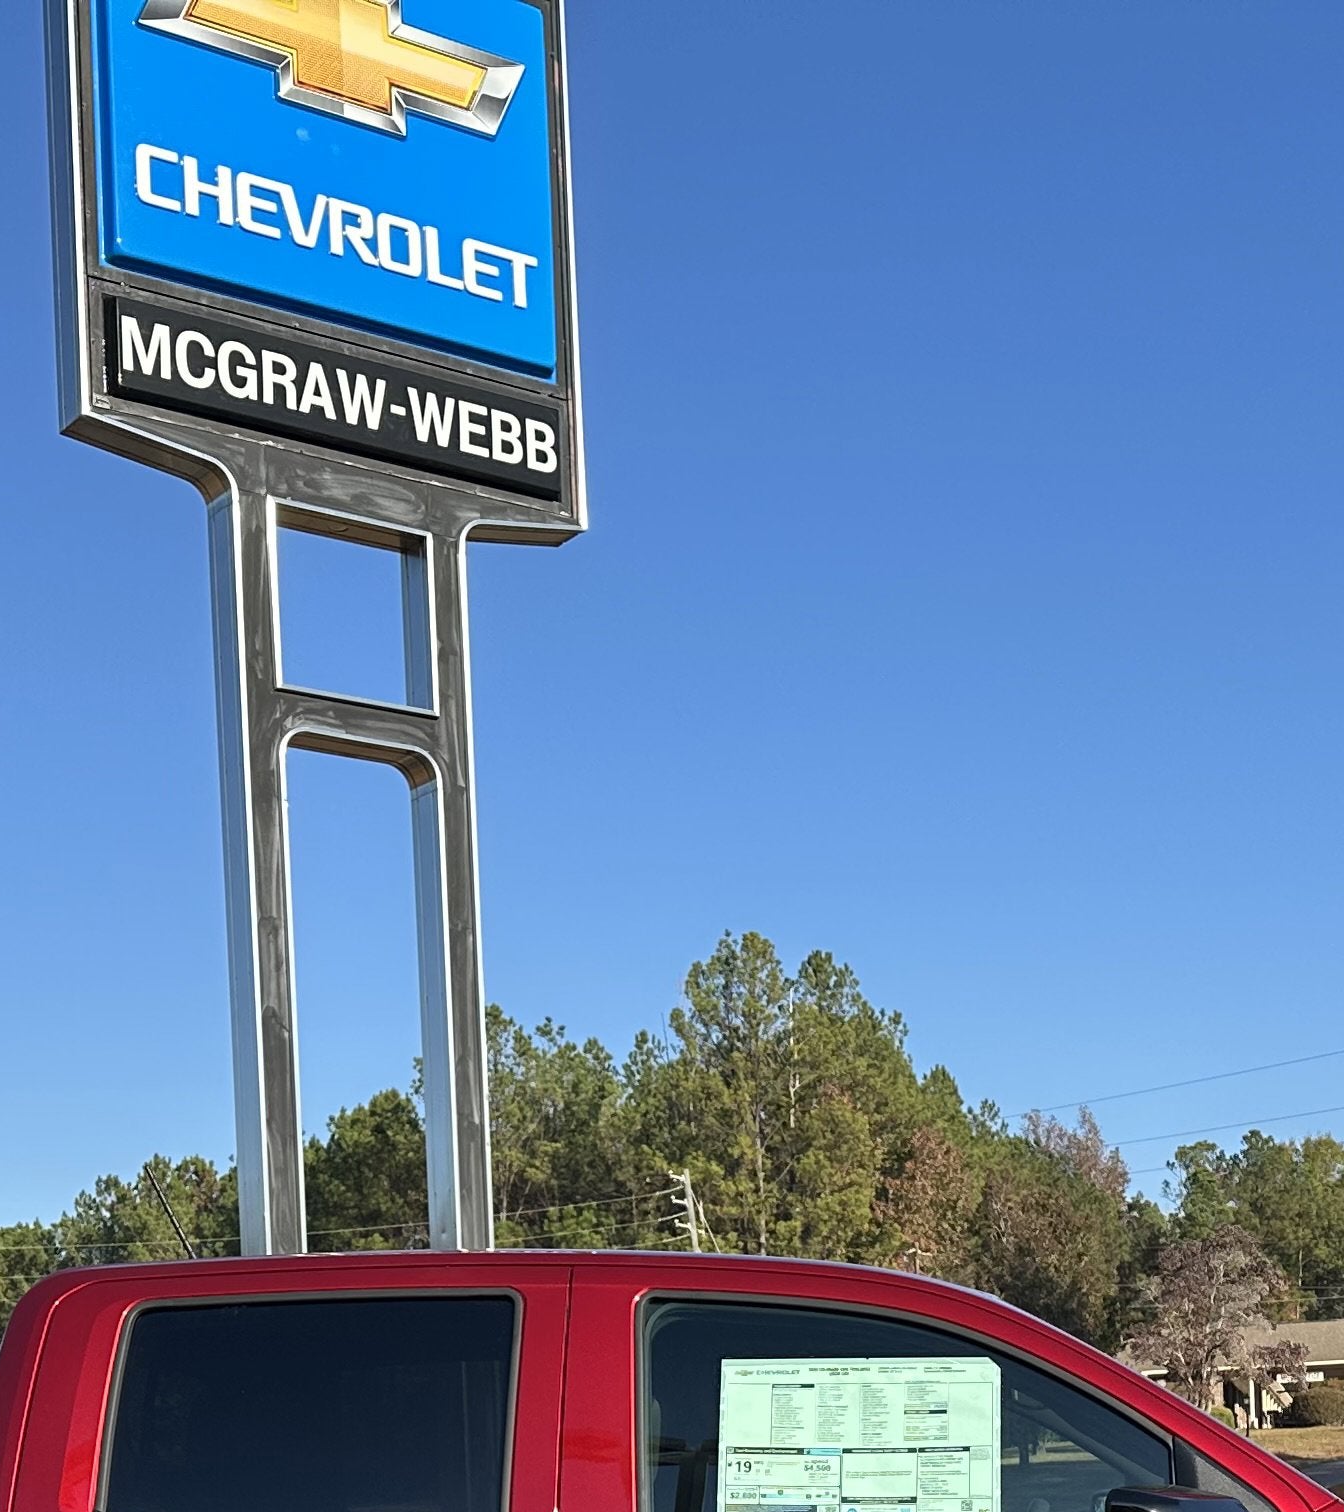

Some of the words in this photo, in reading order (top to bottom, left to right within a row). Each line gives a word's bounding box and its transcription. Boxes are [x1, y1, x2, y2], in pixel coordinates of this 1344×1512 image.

[135, 143, 538, 308] CHEVROLET
[121, 315, 557, 474] MCGRAW-WEBB
[735, 1461, 752, 1473] 19
